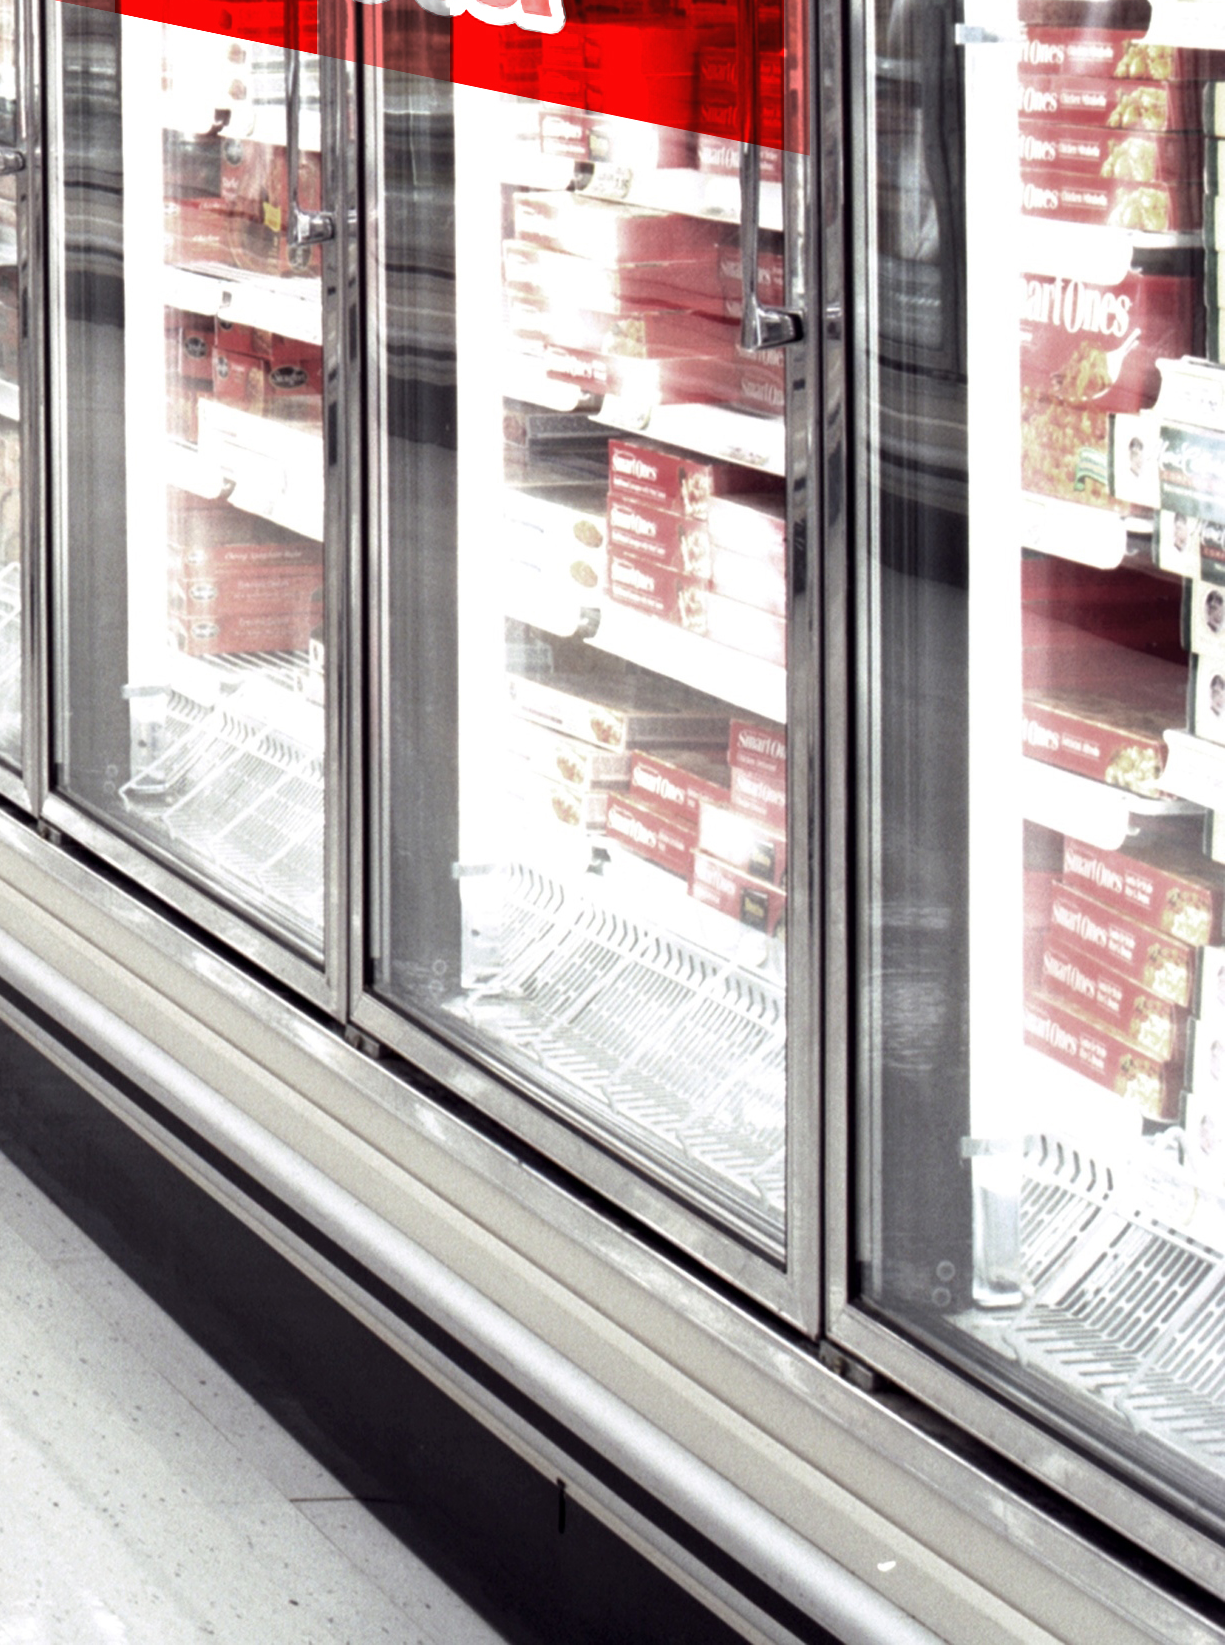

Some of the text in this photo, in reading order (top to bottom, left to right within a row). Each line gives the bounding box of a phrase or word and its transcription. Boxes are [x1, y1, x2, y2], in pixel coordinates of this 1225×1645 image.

[1063, 281, 1133, 338] Ones
[737, 731, 771, 756] Smart
[1064, 848, 1097, 882] Smart
[1052, 900, 1082, 935] Smart
[1043, 950, 1072, 986] Smart
